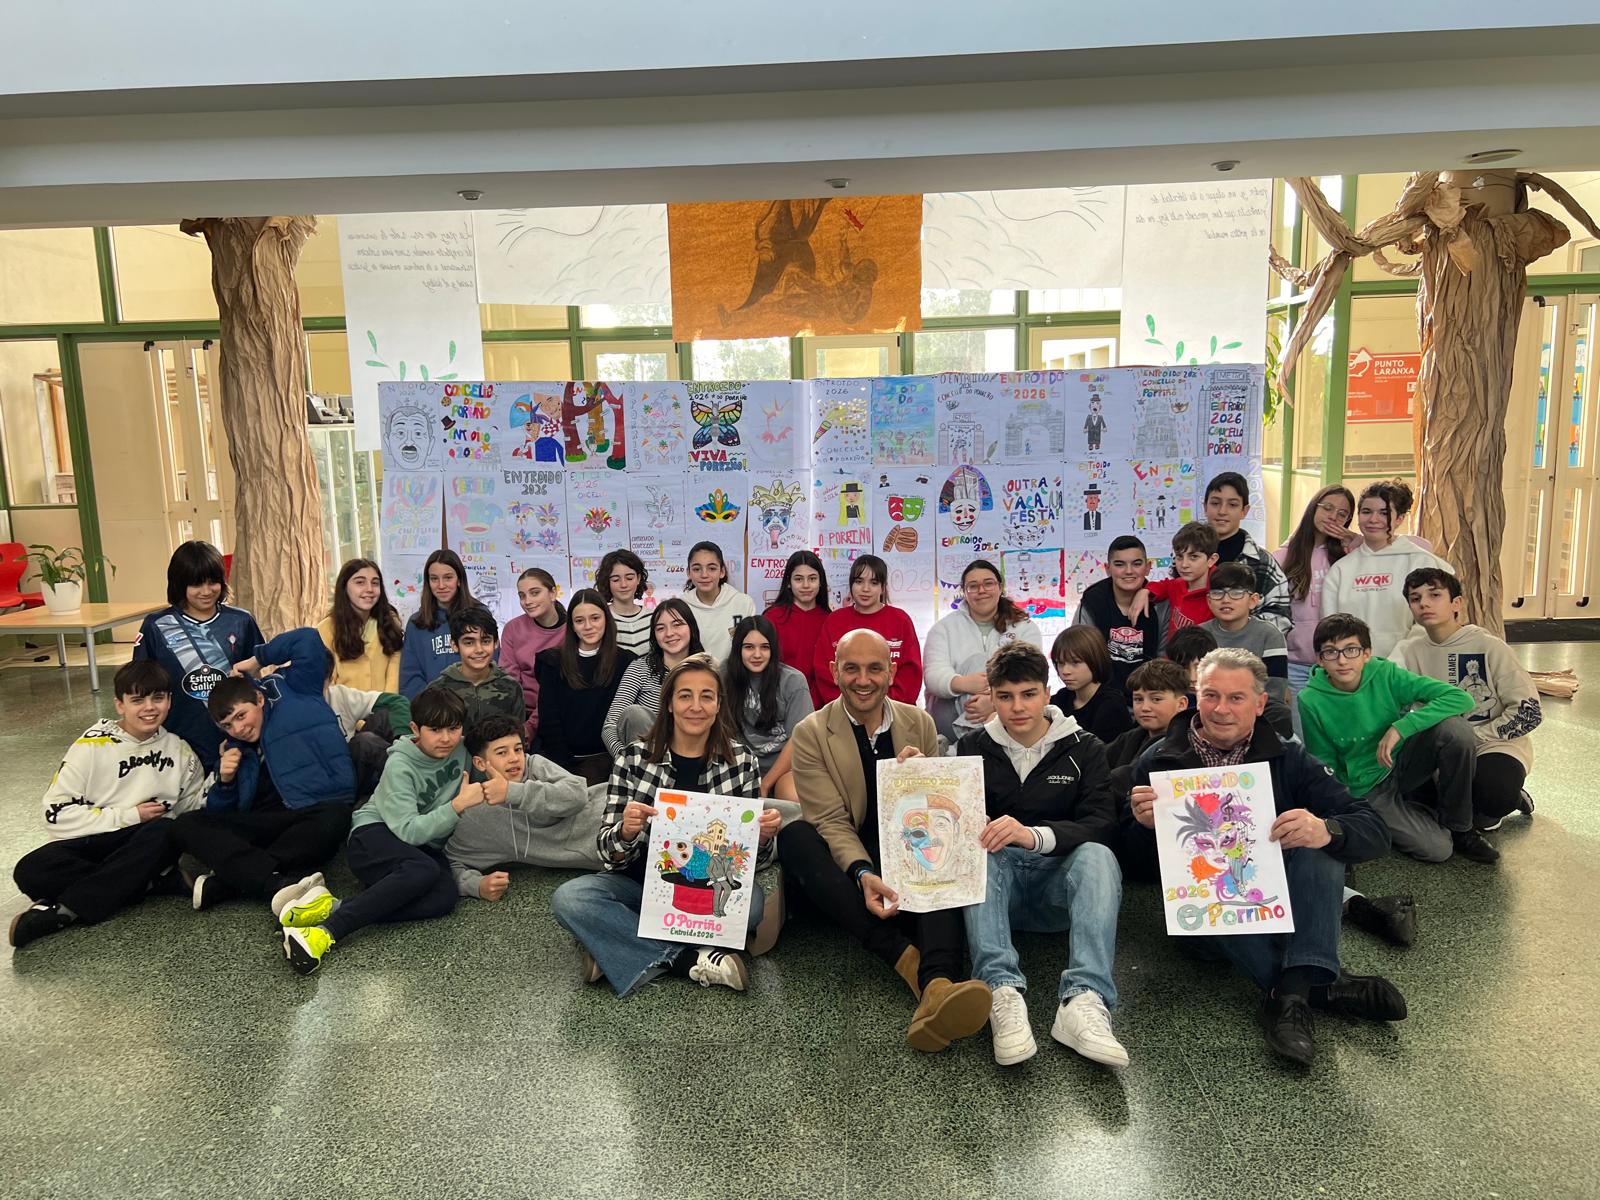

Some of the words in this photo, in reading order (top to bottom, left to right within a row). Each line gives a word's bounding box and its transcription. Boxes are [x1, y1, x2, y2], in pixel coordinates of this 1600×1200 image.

[1374, 367, 1415, 375] LARANXA
[1000, 372, 1064, 384] ENTROIDO
[1014, 389, 1046, 400] 2026
[1210, 412, 1242, 424] 2026
[503, 470, 562, 484] ENTROIDO
[521, 484, 548, 495] 2026
[1007, 477, 1048, 492] OUTRA
[1010, 507, 1060, 525] FESTA!
[888, 569, 932, 592] 026
[1447, 654, 1457, 677] RAMEN
[190, 674, 222, 683] Estrella
[1166, 884, 1210, 901] 2026
[663, 913, 675, 926] O
[677, 914, 722, 932] Porriño
[670, 927, 696, 937] Entroido
[697, 929, 714, 938] 2026
